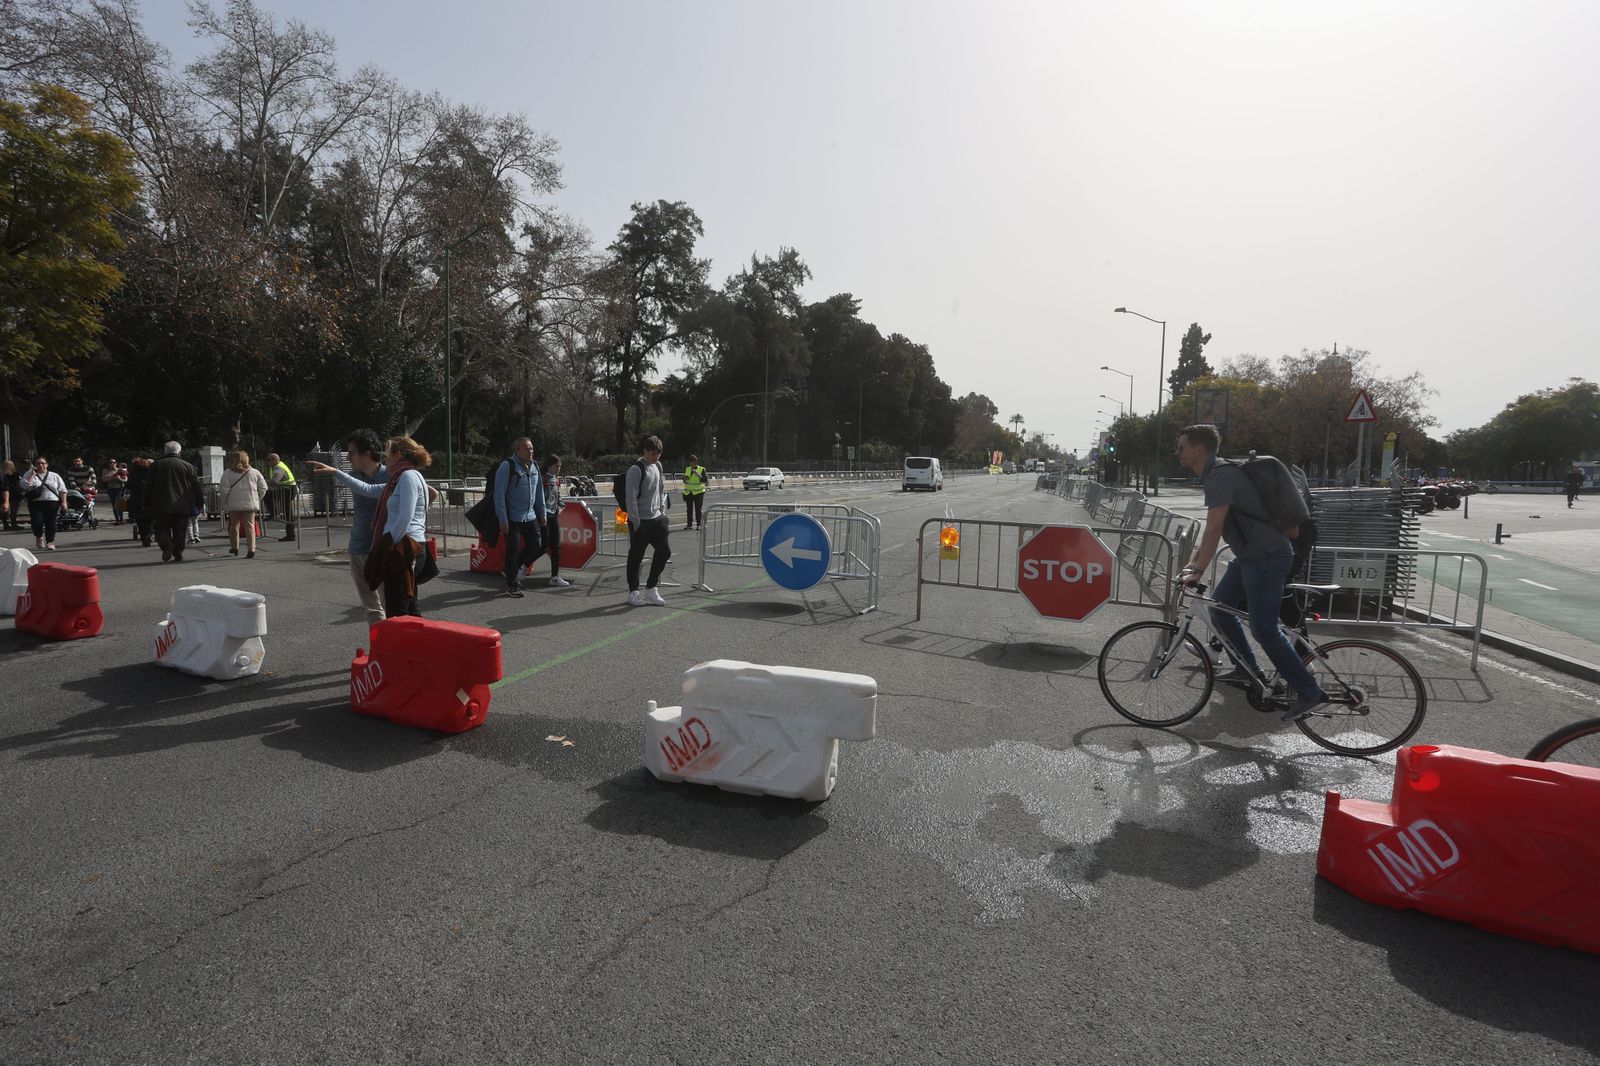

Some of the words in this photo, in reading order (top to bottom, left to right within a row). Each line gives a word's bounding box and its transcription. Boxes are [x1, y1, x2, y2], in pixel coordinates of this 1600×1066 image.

[559, 527, 593, 545] TOP
[471, 547, 487, 568] IMD
[1023, 558, 1104, 584] STOP
[1340, 566, 1378, 579] IMD
[154, 621, 177, 659] IMD
[351, 660, 383, 704] IMD
[660, 717, 712, 772] IMD
[1366, 819, 1460, 892] IMD
